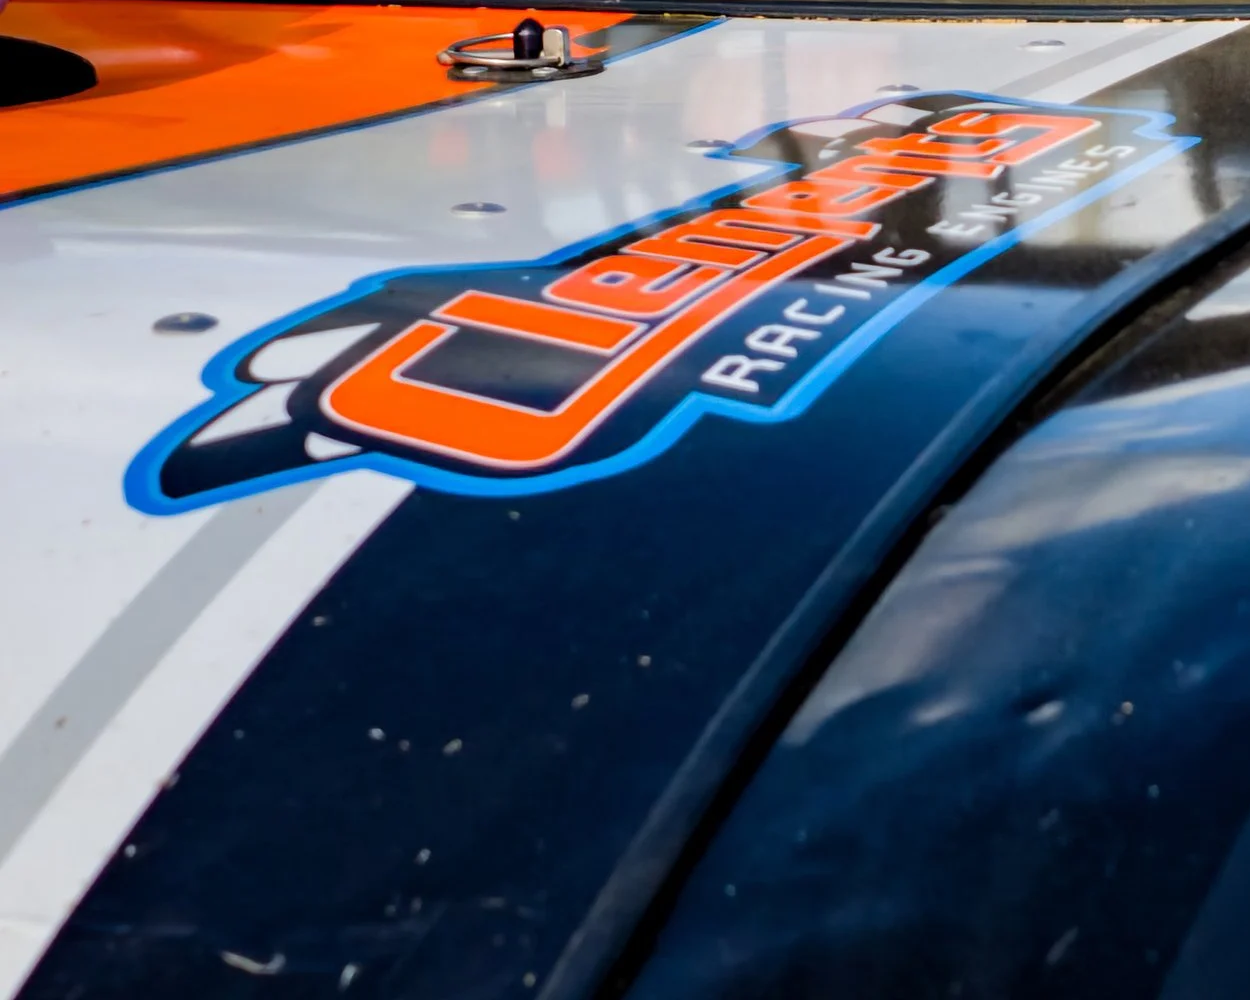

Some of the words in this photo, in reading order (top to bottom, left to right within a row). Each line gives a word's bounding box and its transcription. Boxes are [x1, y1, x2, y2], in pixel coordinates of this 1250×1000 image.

[319, 109, 1103, 470] Clements
[701, 246, 931, 393] RACING
[927, 144, 1136, 238] ENGINES
